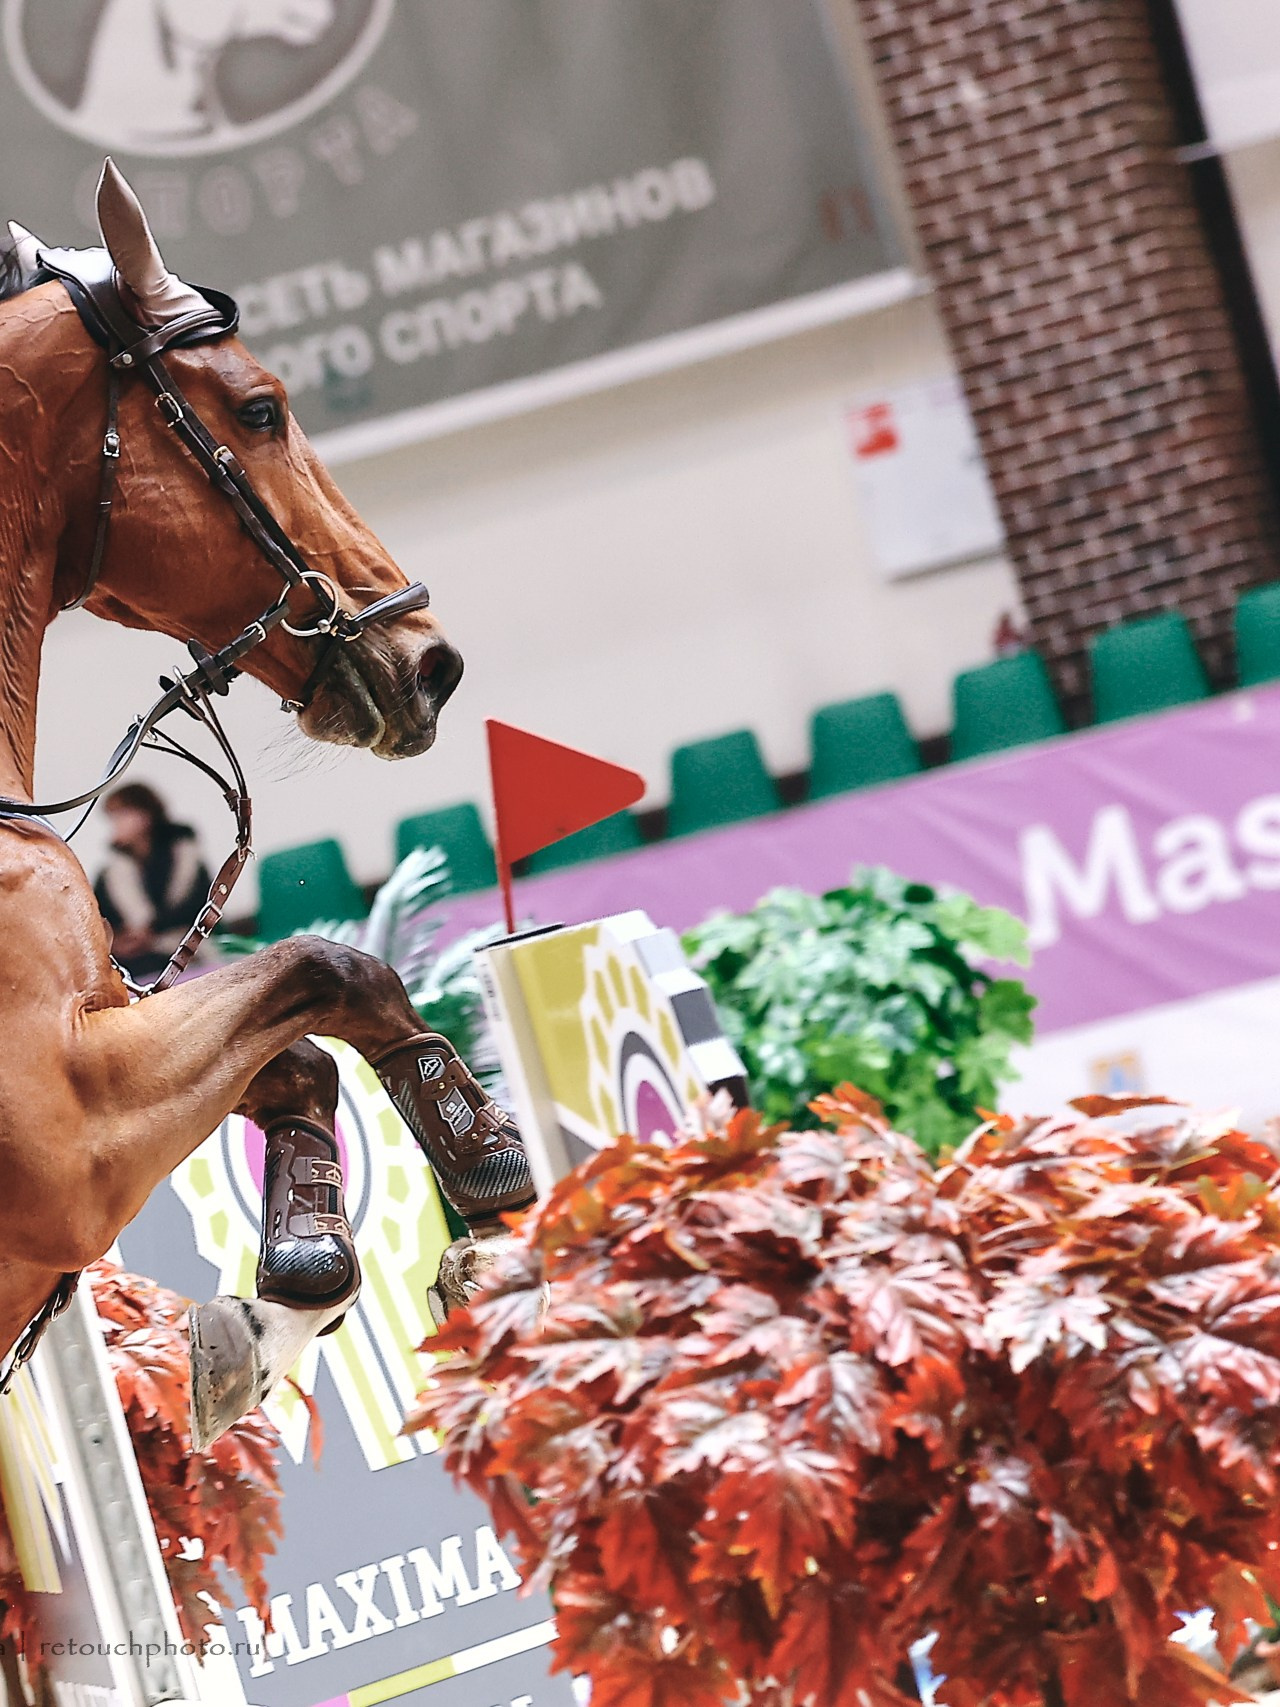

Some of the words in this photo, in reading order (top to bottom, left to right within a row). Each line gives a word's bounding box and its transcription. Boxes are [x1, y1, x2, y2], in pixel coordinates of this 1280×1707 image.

[234, 259, 370, 336] СЕТЬ
[374, 156, 716, 297] МАГАЗИНОВ
[379, 260, 606, 365] СПОРТА
[236, 1524, 523, 1679] MAXIMA
